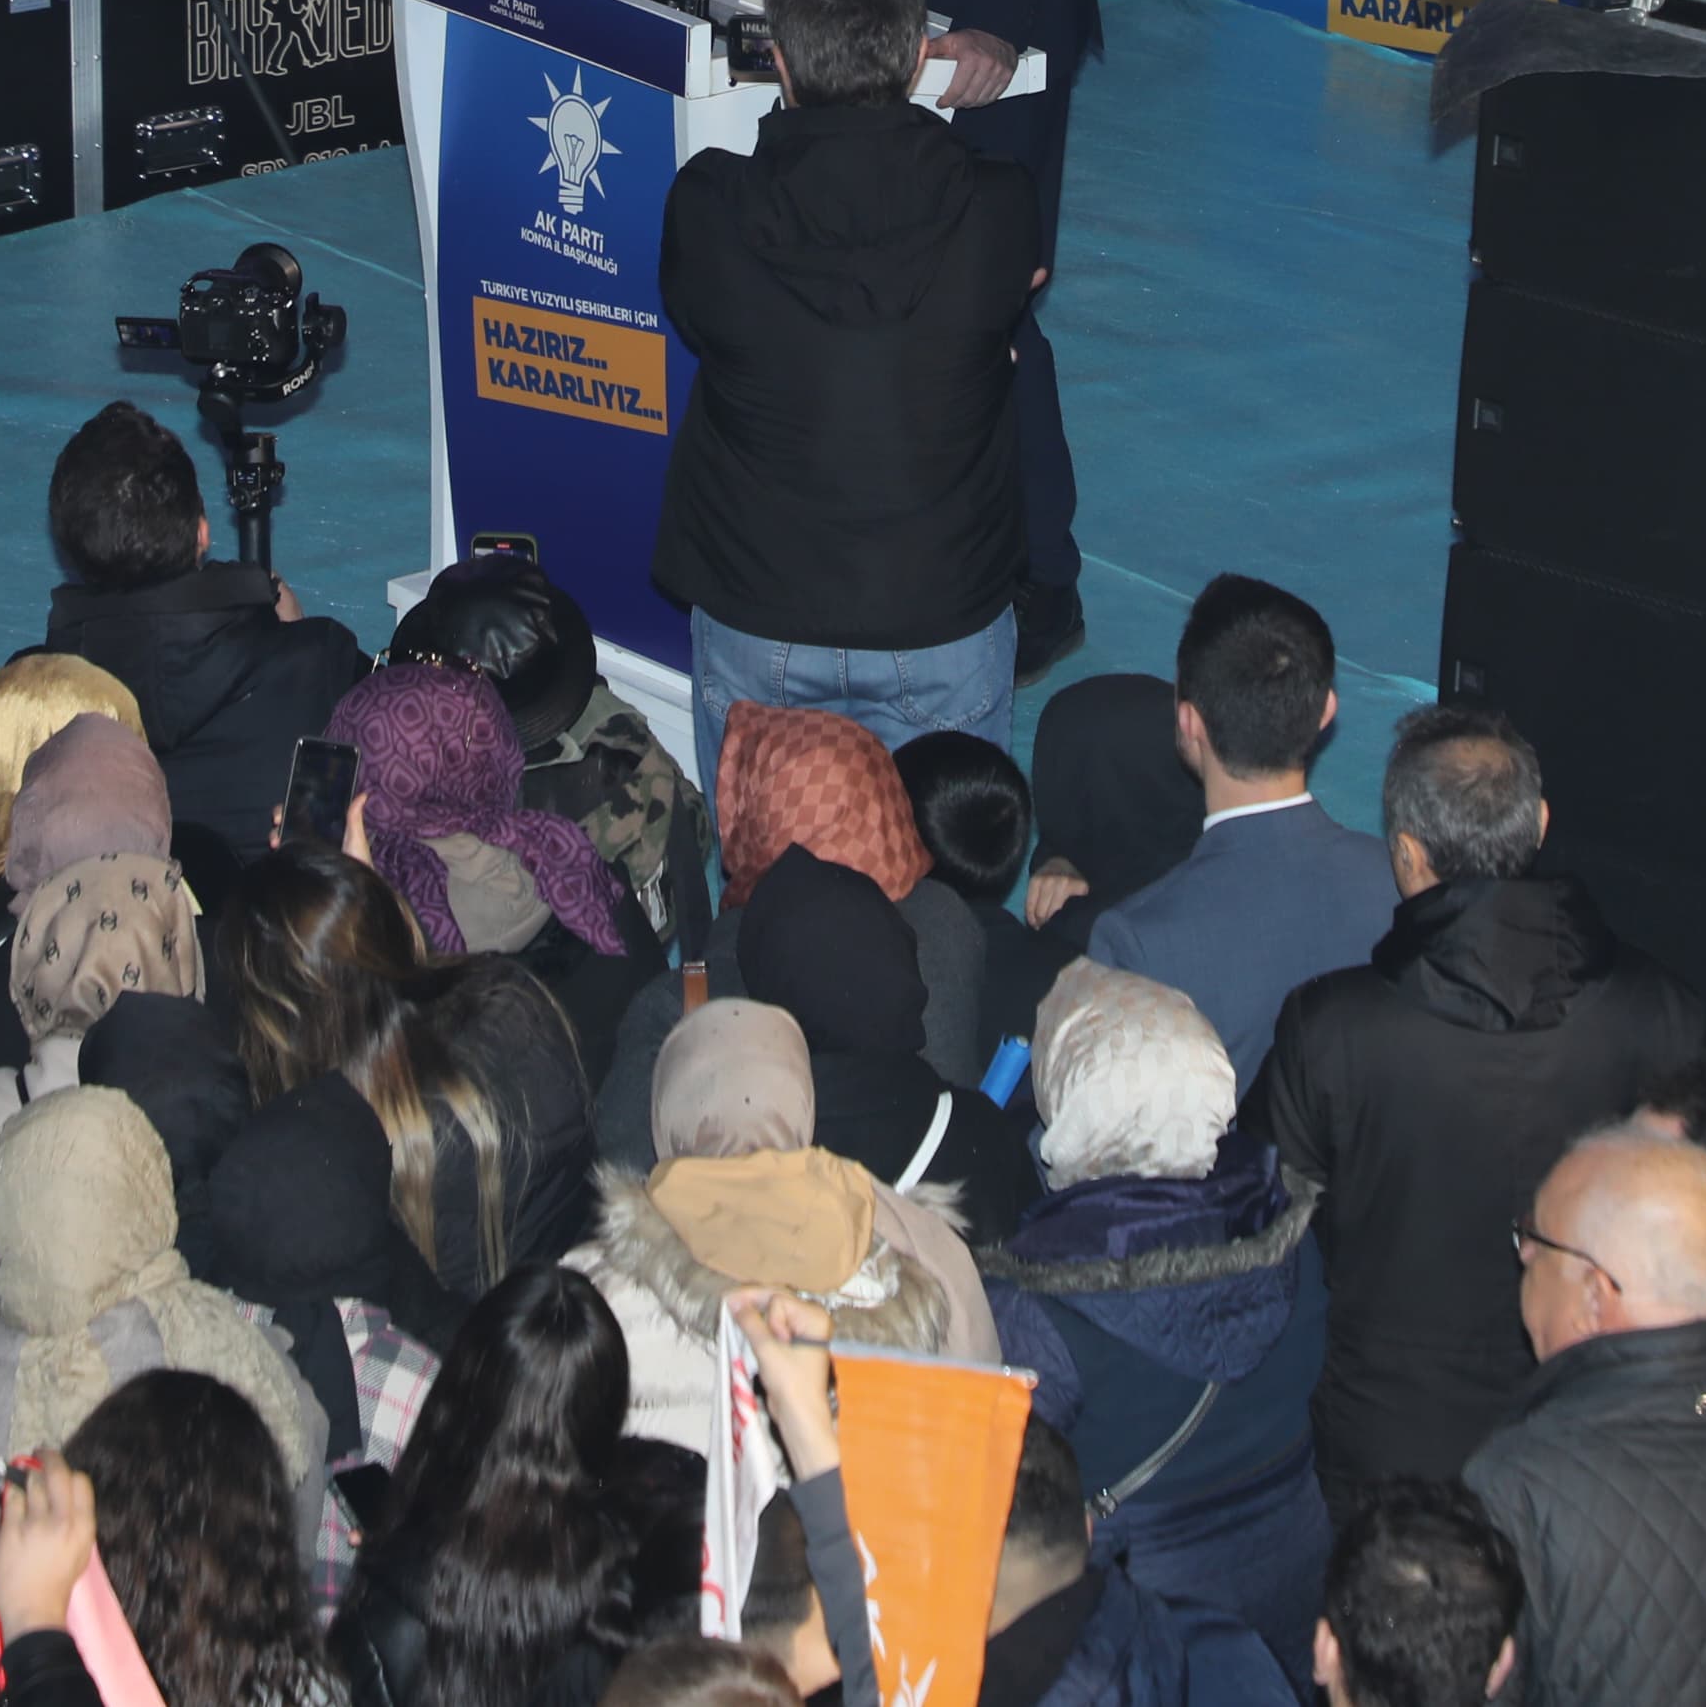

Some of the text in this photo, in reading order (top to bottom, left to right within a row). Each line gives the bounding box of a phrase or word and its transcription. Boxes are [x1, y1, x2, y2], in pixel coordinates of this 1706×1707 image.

[285, 95, 356, 137] JBL
[534, 210, 557, 236] AK
[520, 227, 553, 251] KONYA
